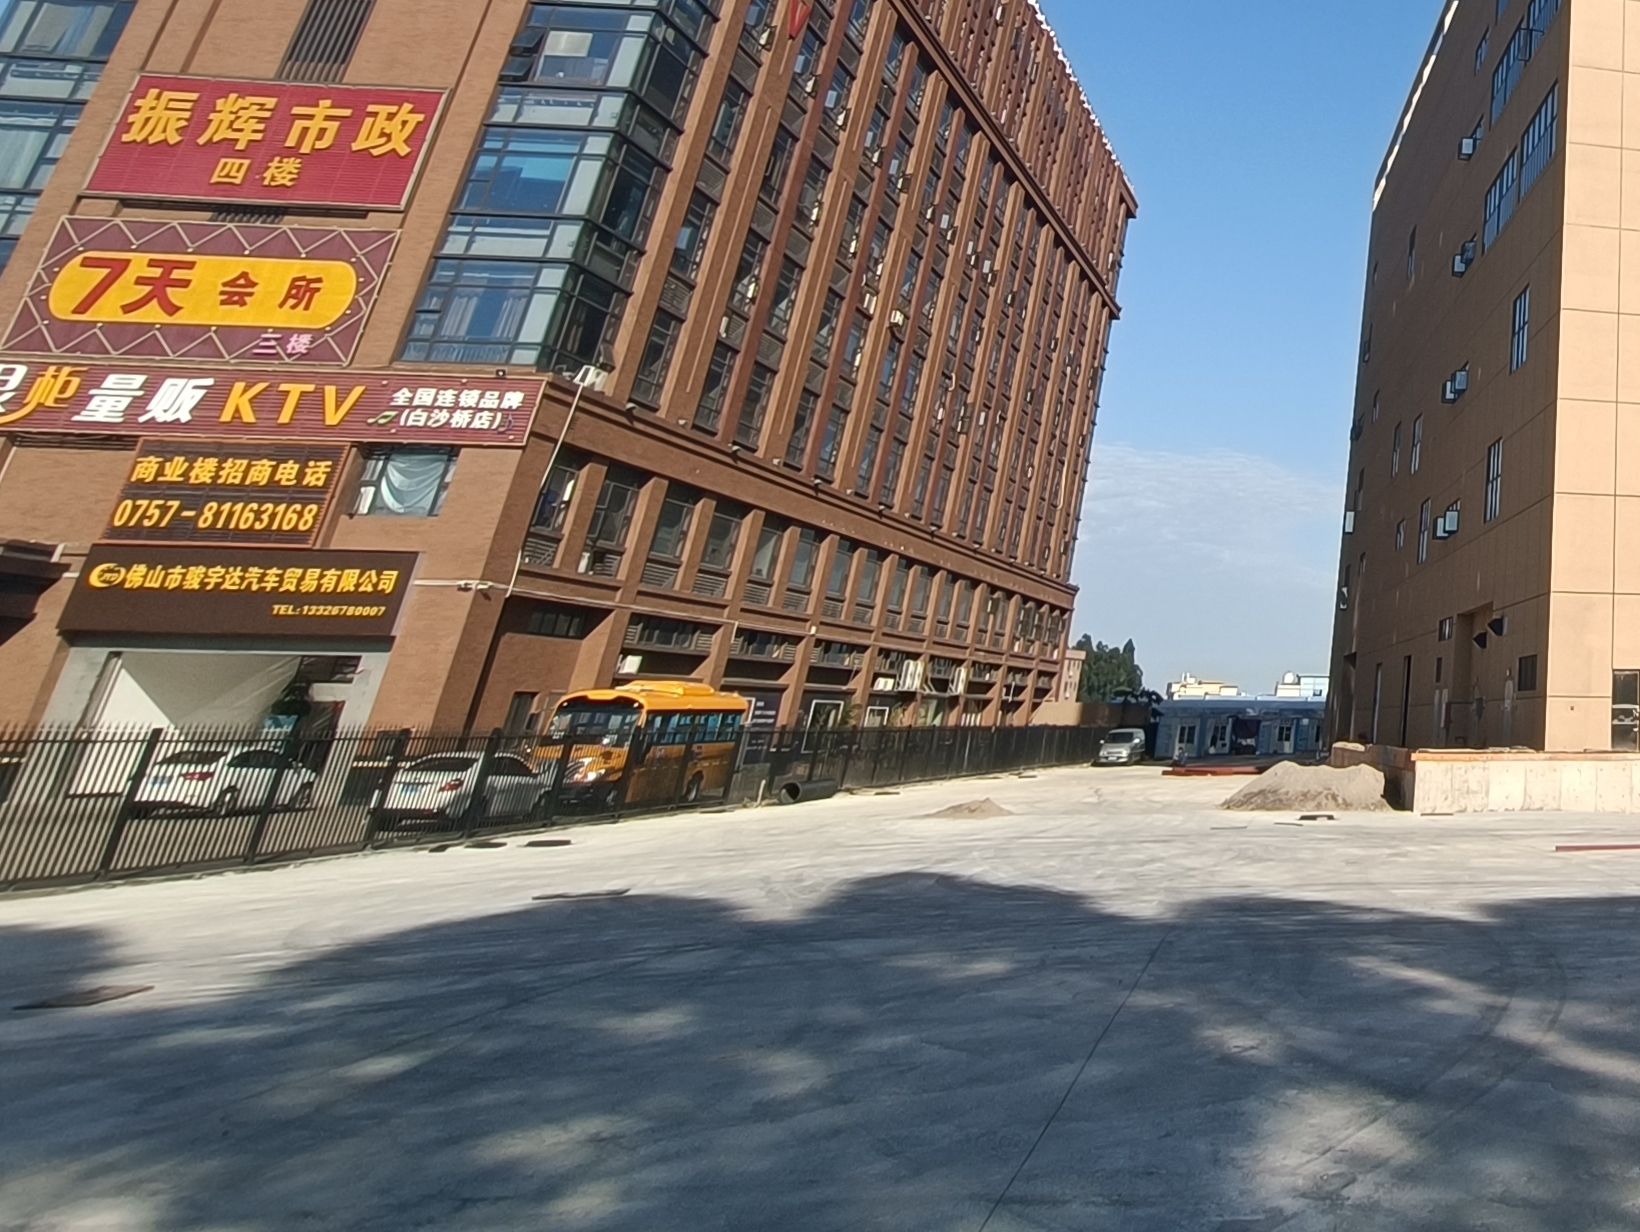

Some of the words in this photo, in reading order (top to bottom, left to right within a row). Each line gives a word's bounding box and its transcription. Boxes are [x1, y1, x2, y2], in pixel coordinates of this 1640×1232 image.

[121, 87, 426, 158] 振辉市政
[209, 156, 302, 188] 四楼
[252, 332, 314, 356] 三楼
[218, 380, 366, 427] KTV
[389, 387, 525, 410] 全国连锁品牌
[399, 408, 502, 430] (白沙桥店)
[130, 455, 332, 487] 商业楼招商电话
[113, 499, 318, 531] 0757-81163168
[123, 563, 399, 593] 佛山市骏宇达汽车贸易有限公司
